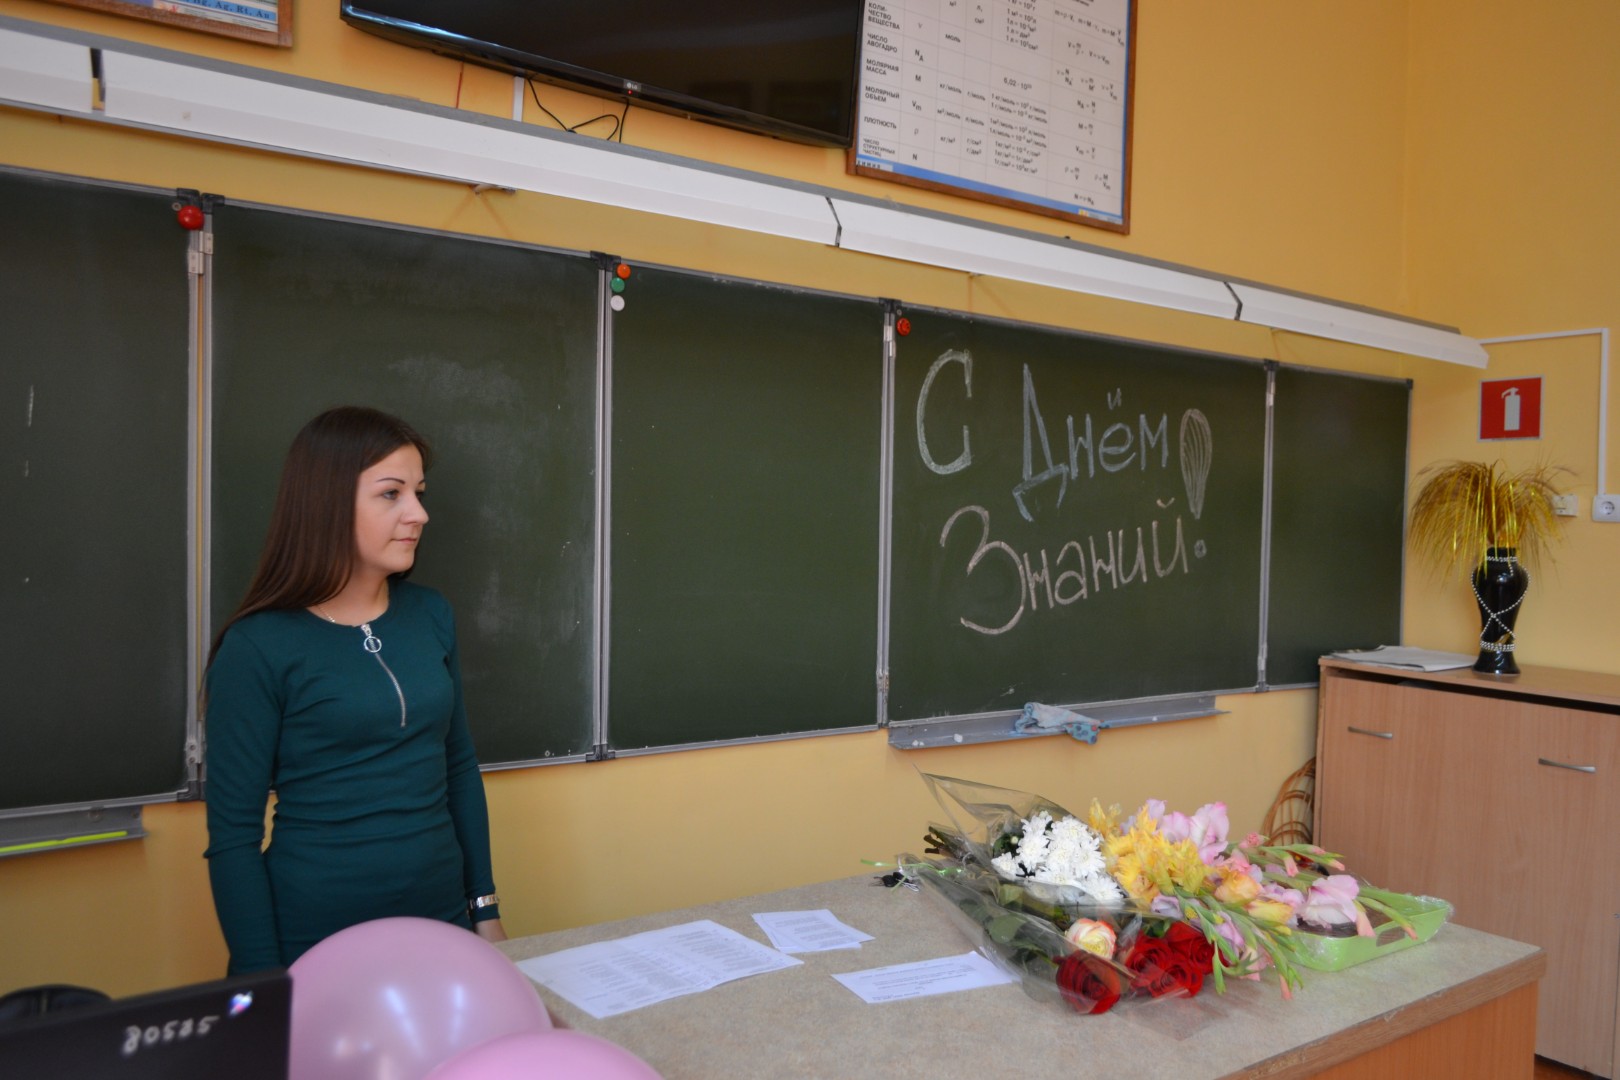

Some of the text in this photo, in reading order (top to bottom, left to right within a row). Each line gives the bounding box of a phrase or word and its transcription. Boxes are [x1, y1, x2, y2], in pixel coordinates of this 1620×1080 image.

[256, 9, 270, 19] Au
[868, 9, 892, 20] ЧЕСТВО
[867, 15, 900, 30] ВЕЩЕСТВА
[867, 32, 888, 44] ЧИСЛО
[945, 33, 961, 43] моль
[867, 39, 898, 53] АВОГАДРО
[866, 58, 899, 72] МОЛЯРНАЯ
[866, 65, 887, 76] МАССА
[1004, 77, 1016, 87] 6,02
[865, 85, 900, 99] МОЛЯРНЫЙ
[865, 92, 887, 103] ОБЪЕМ
[864, 116, 897, 130] ПЛОТНОСТЬ
[916, 348, 973, 475] С
